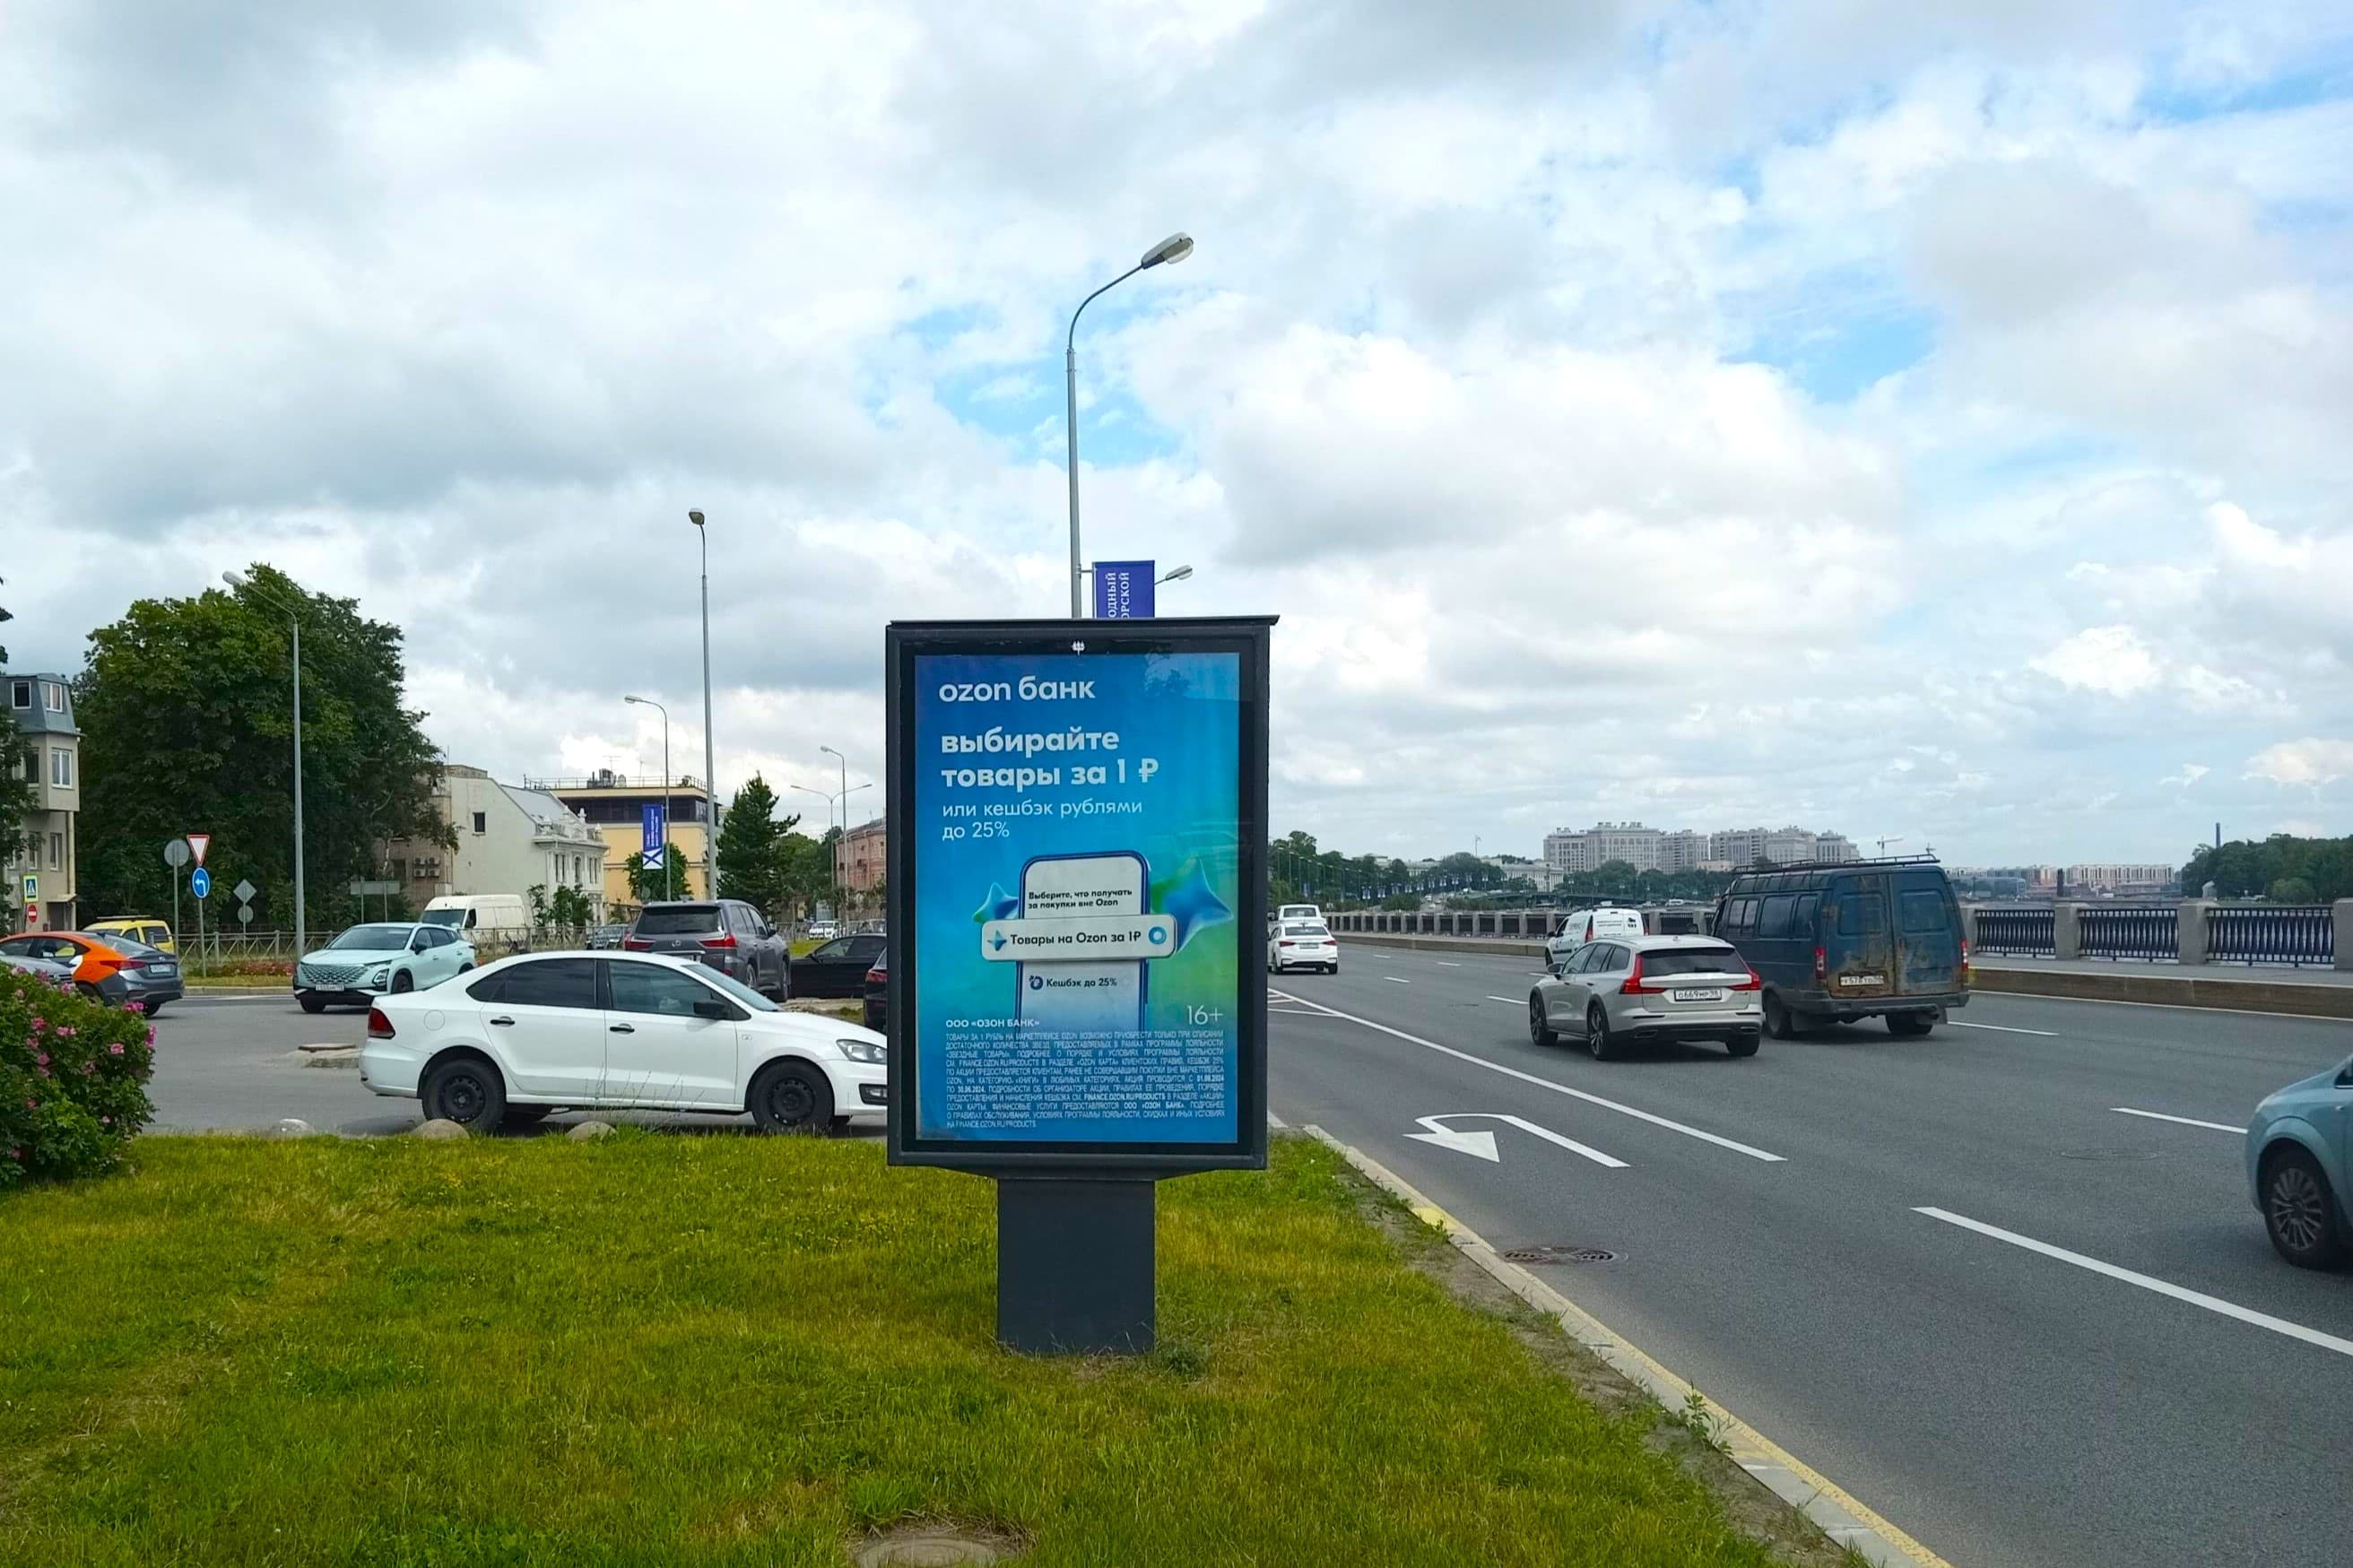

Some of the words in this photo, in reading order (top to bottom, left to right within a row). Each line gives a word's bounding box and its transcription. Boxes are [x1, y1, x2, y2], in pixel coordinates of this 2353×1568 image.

[939, 682, 1011, 702] ozon
[1019, 675, 1096, 701] банк
[942, 726, 1119, 758] выбирайте
[942, 767, 1060, 792] товары
[1072, 766, 1106, 785] за
[1117, 759, 1126, 784] 1
[942, 803, 976, 817] или
[984, 800, 1053, 816] кешбэк
[1061, 798, 1142, 819] рублями
[942, 825, 966, 841] до
[972, 822, 1010, 838] 25%
[1029, 891, 1072, 900] Выберите,
[1091, 889, 1133, 898] получать
[1040, 901, 1076, 910] покупки
[1096, 898, 1118, 906] Ozon
[1011, 934, 1055, 947] Товары
[1058, 935, 1073, 943] на
[1076, 931, 1107, 943] Ozon
[1111, 933, 1125, 942] за
[1046, 978, 1081, 988] Кешбэк
[1084, 979, 1096, 987] до
[1098, 978, 1117, 986] 25%
[946, 1019, 969, 1027] ООО
[971, 1019, 1005, 1027] «ОЗОН
[1187, 1005, 1223, 1025] 16+
